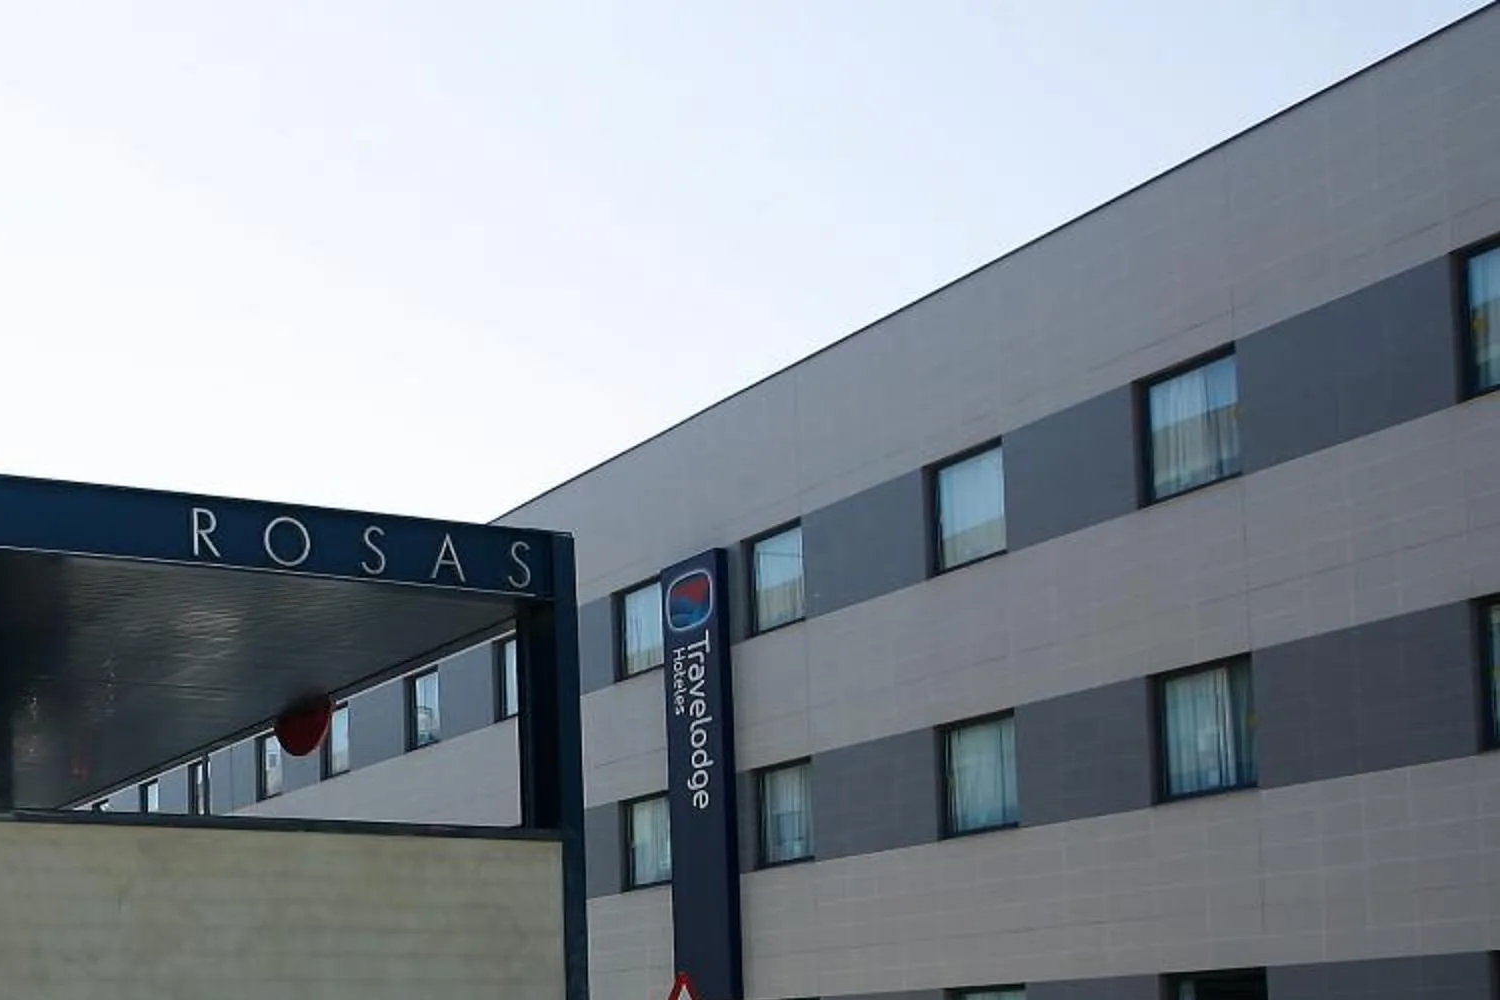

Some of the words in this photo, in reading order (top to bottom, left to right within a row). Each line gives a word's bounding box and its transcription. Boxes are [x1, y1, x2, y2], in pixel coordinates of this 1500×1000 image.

[191, 506, 533, 589] ROSAS
[671, 646, 688, 716] Hoteles
[686, 629, 715, 810] Travelodge
